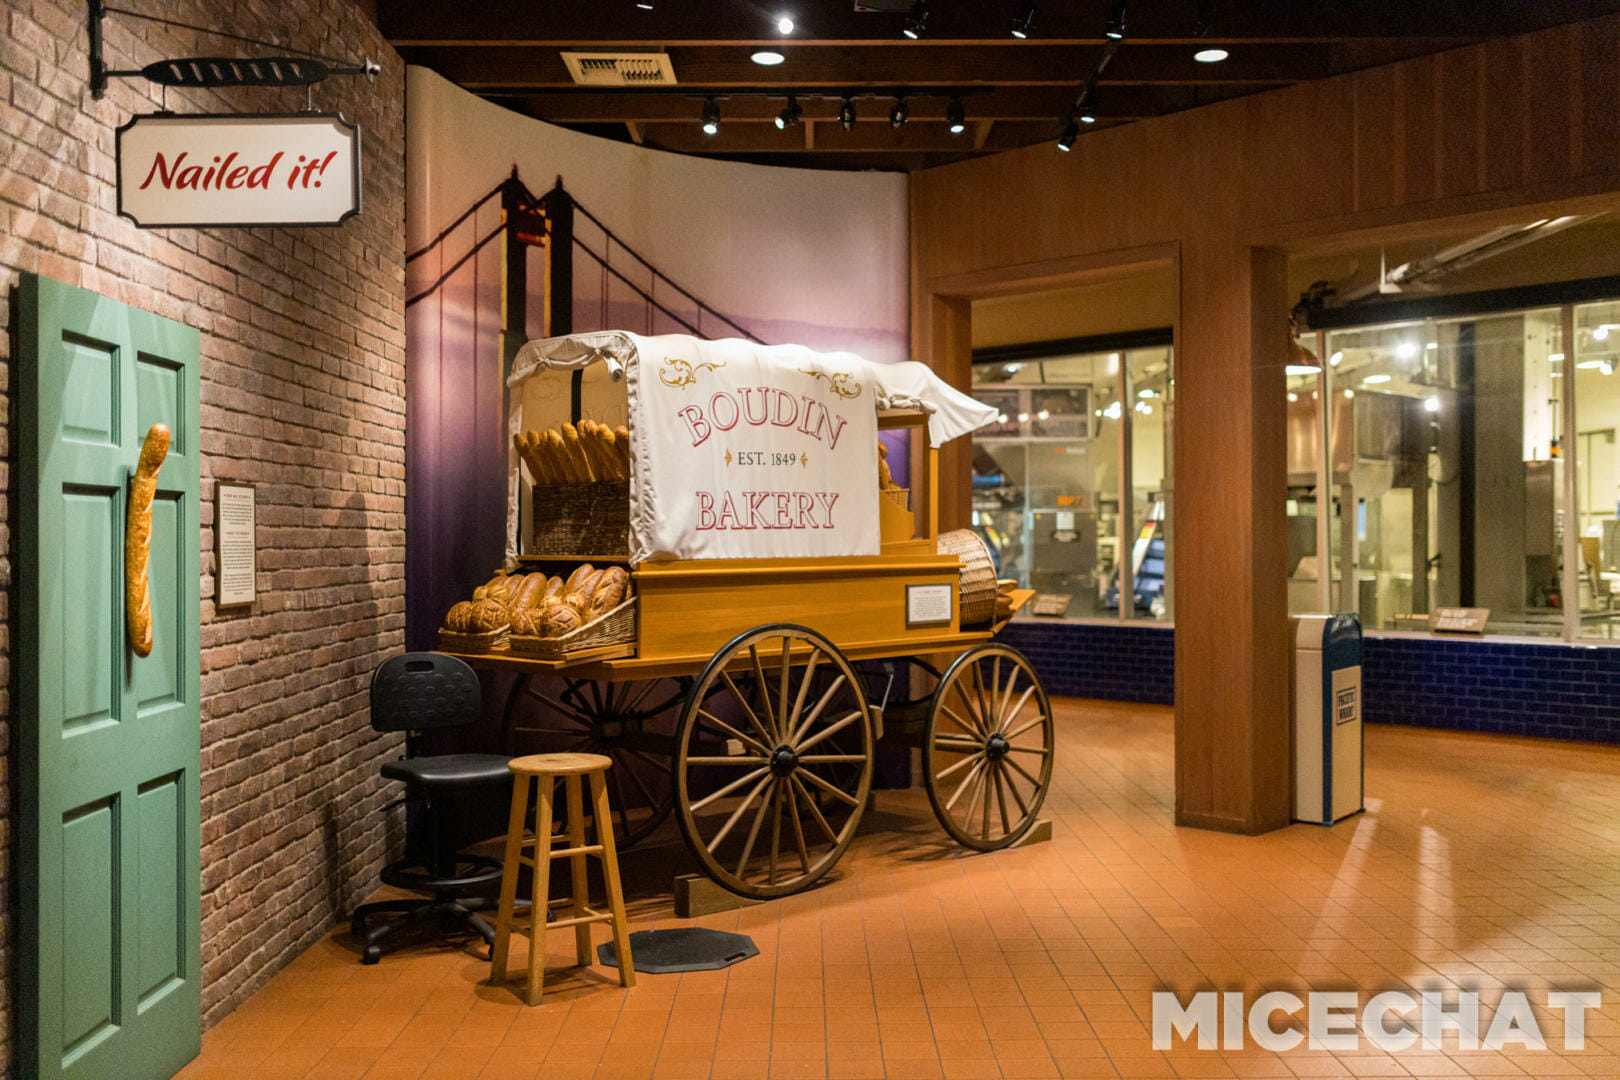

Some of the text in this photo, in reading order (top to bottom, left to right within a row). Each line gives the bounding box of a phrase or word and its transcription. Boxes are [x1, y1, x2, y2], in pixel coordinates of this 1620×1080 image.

[139, 150, 338, 191] Nailed it!
[678, 386, 848, 450] BOUDIN
[737, 451, 796, 466] EST. 1849
[695, 490, 839, 531] BAKERY
